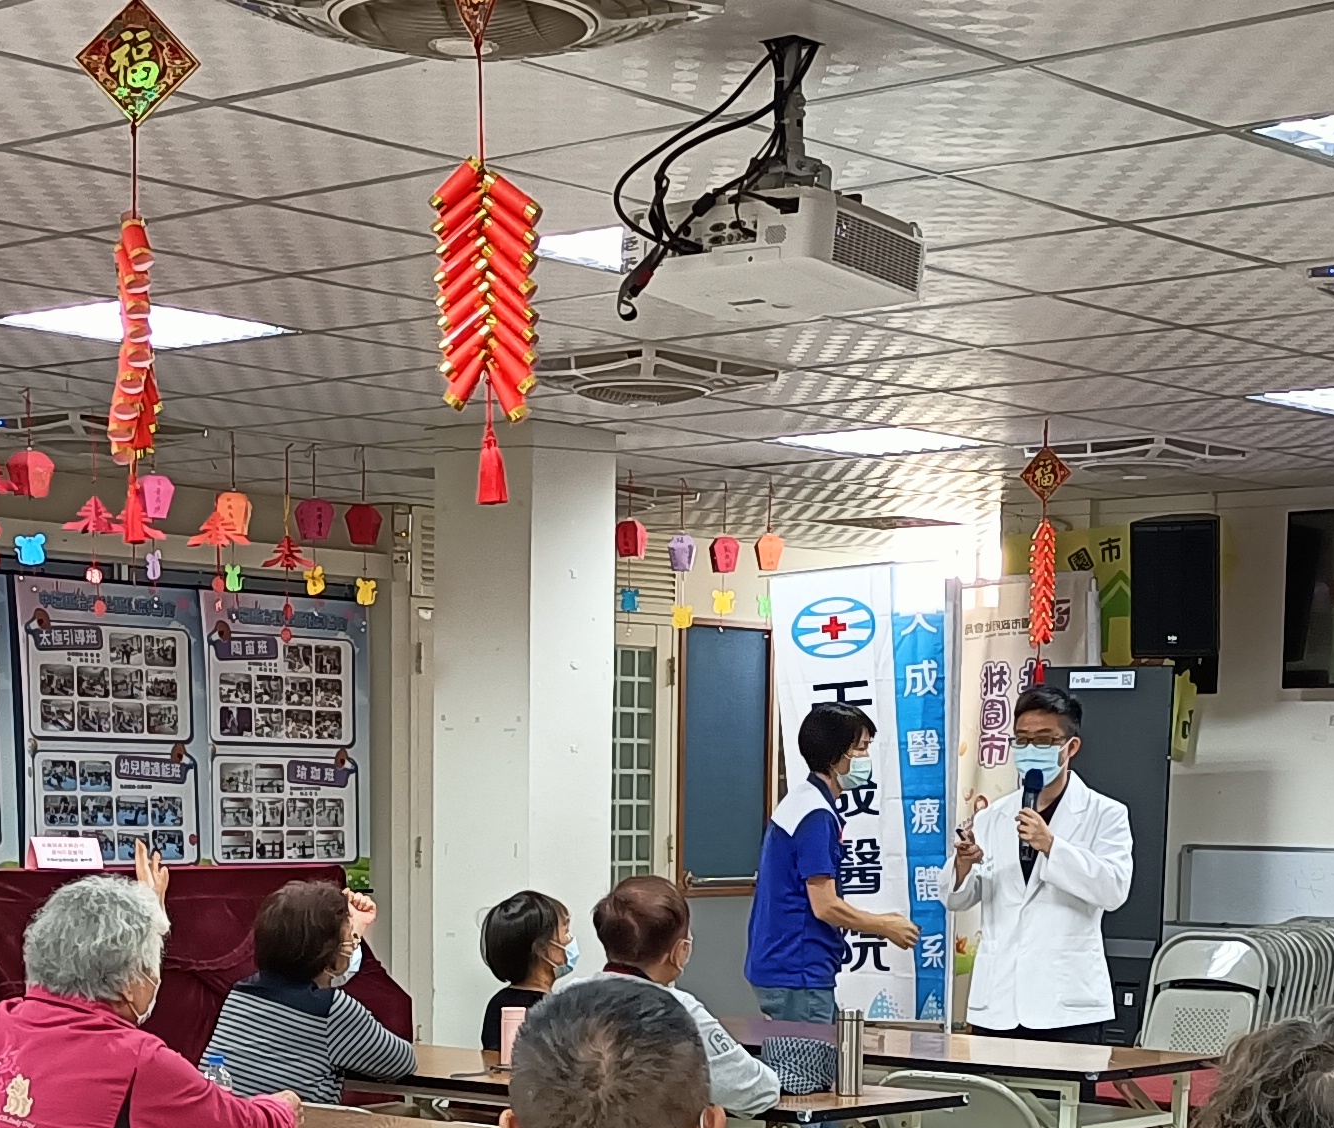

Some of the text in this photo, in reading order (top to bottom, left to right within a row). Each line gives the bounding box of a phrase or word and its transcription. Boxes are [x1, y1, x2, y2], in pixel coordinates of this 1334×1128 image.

[109, 30, 160, 89] 福
[1034, 459, 1055, 487] 福
[39, 627, 98, 646] 太極引導班
[119, 758, 182, 779] 幼兒體適能班
